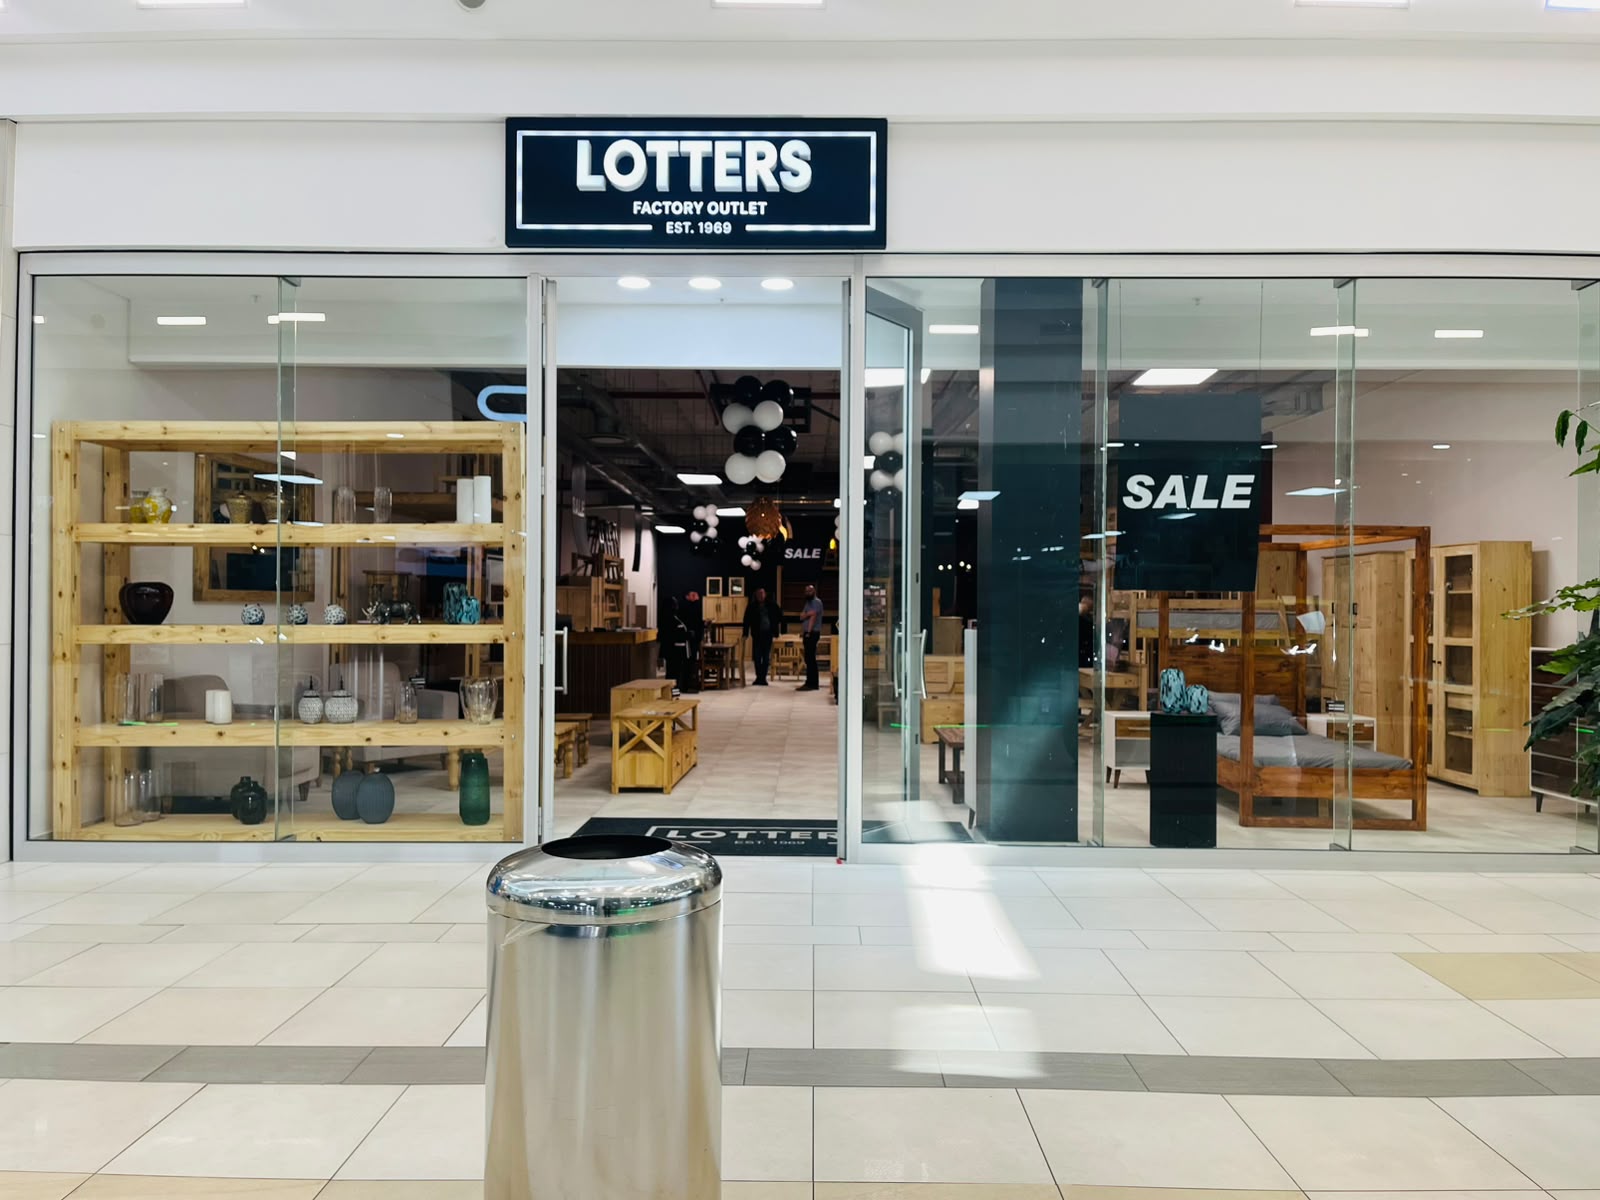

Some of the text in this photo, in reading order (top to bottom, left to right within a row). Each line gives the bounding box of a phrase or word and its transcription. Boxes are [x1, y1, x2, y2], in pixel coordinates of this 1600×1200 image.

[576, 138, 813, 193] LOTTERS
[632, 200, 768, 216] FACTORY OUTLET
[665, 221, 733, 235] EST. 1969
[1122, 474, 1255, 509] SALE
[784, 548, 821, 559] SALE
[666, 830, 837, 840] LOTTER
